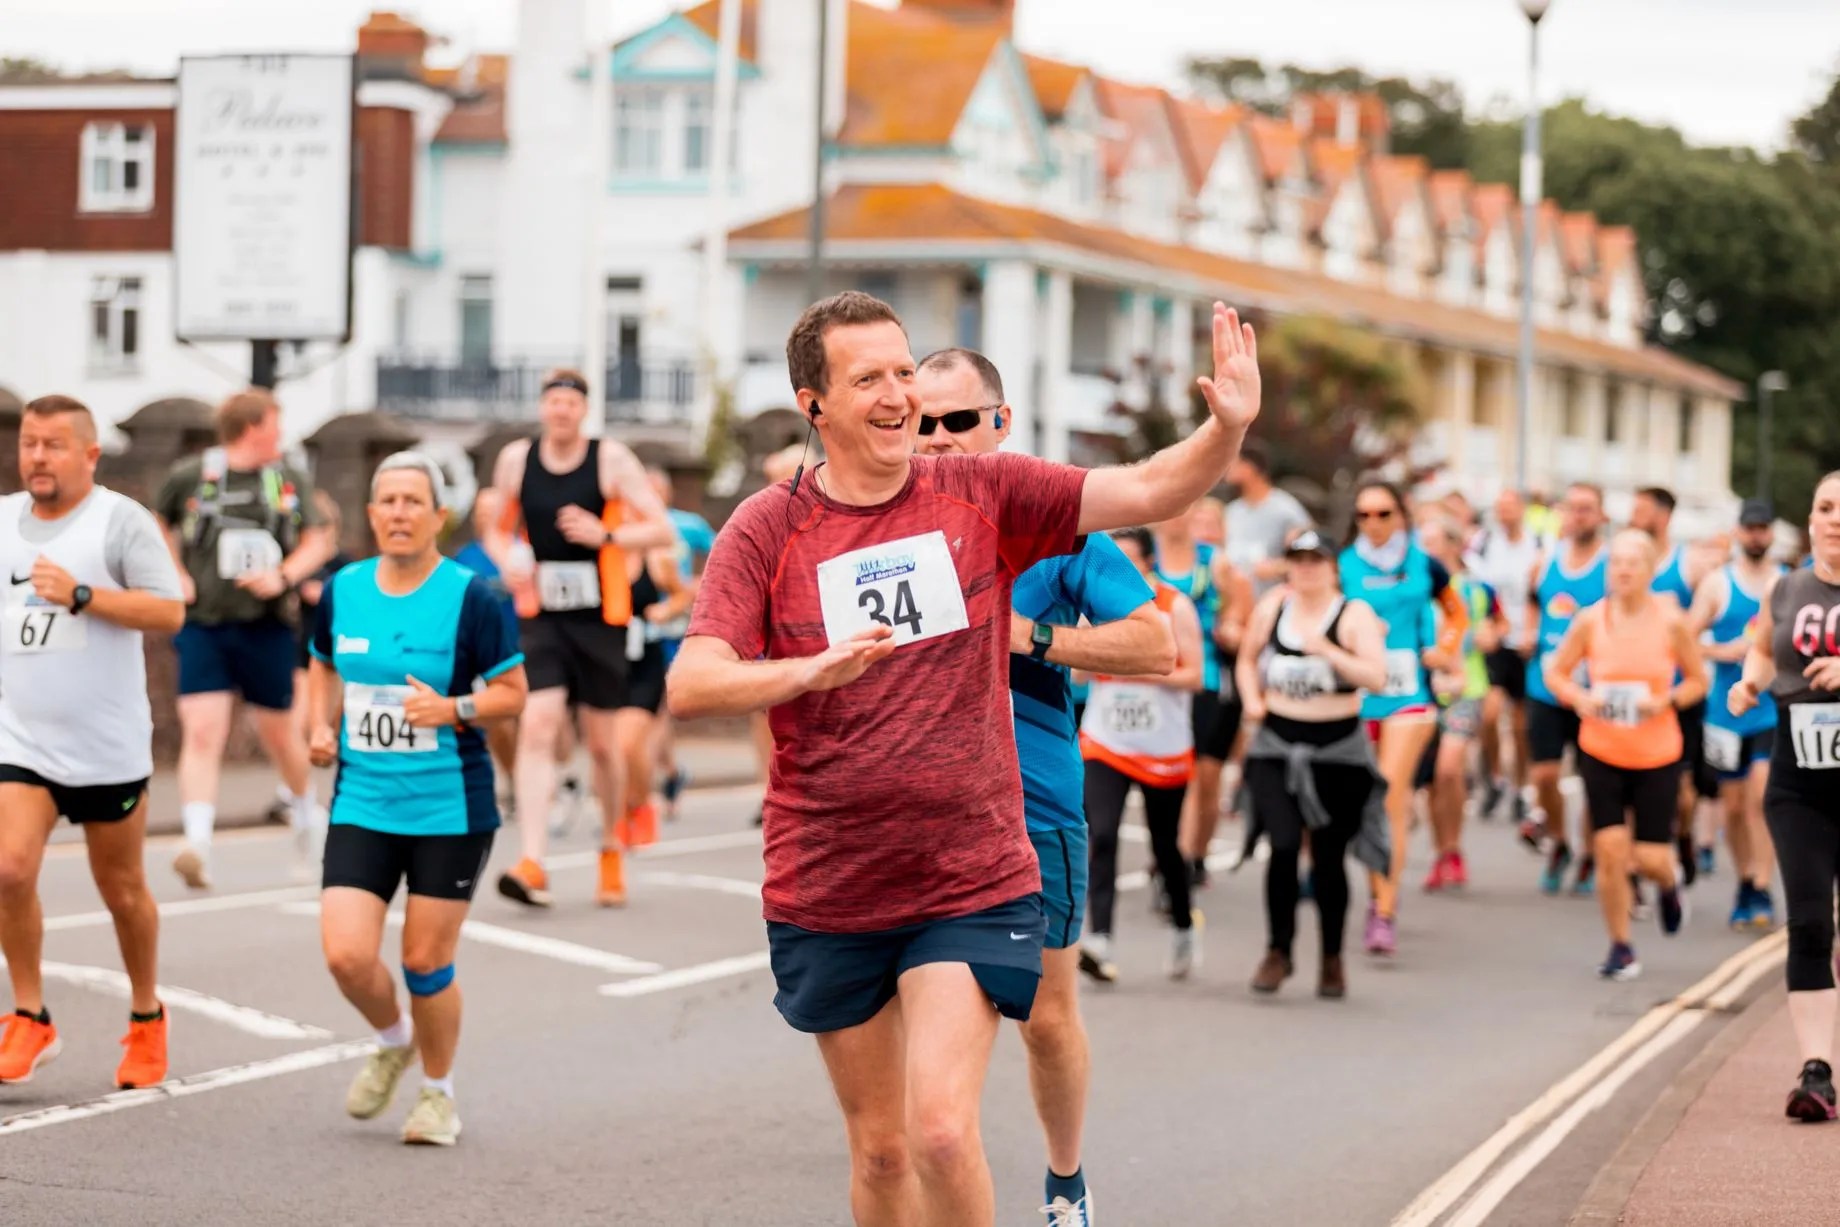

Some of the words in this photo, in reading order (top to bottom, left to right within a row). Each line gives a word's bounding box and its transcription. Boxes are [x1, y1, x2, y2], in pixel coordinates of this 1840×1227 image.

[861, 573, 875, 584] Half
[876, 566, 908, 580] Marathon
[858, 580, 922, 636] 34
[20, 612, 57, 646] 67
[358, 711, 417, 747] 404
